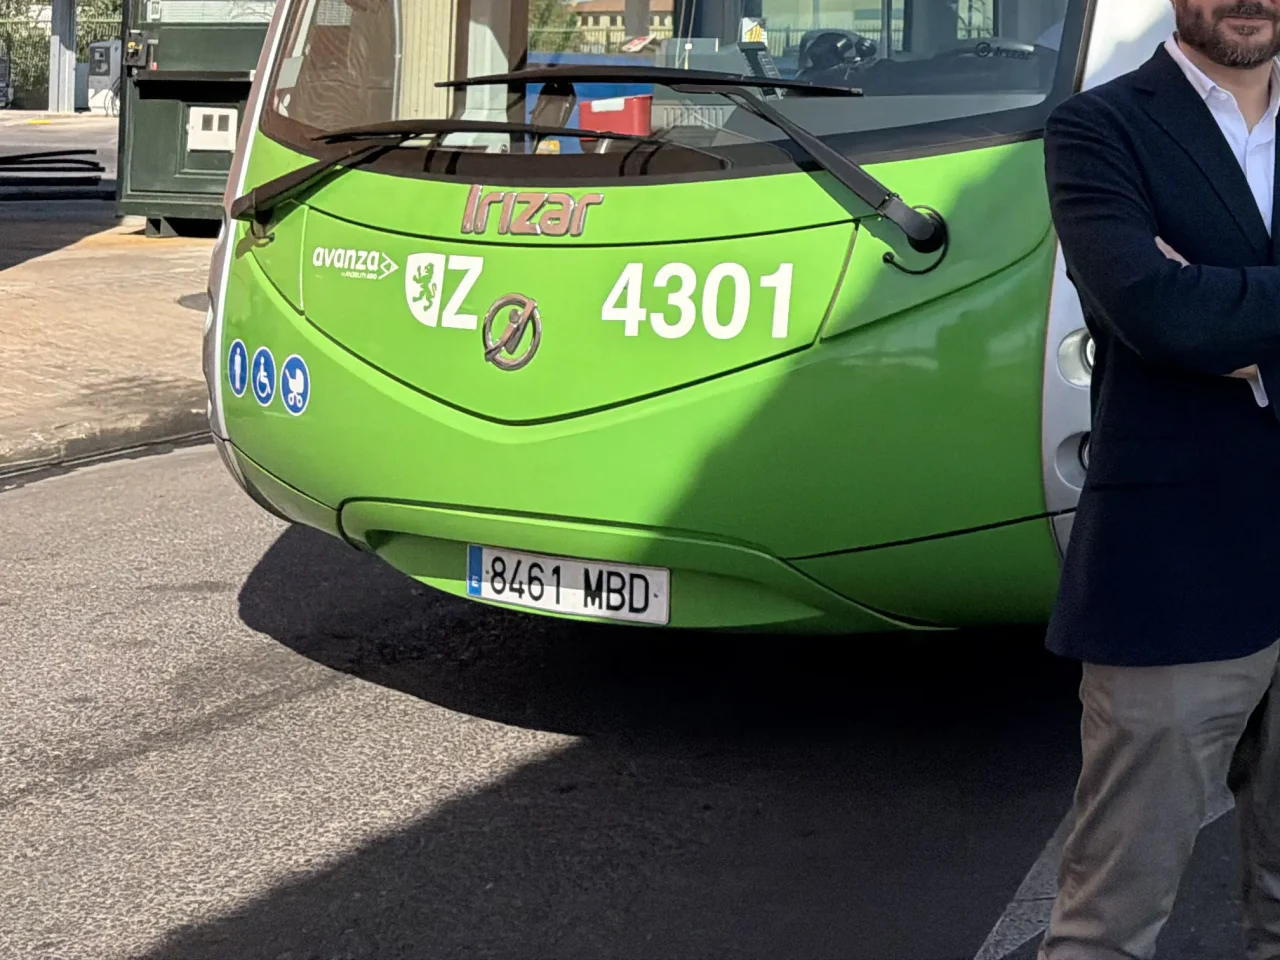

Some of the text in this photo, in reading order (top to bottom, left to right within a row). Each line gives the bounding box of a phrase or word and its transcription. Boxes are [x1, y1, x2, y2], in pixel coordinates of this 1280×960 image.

[460, 184, 605, 238] Irizar
[312, 246, 380, 272] avanza
[440, 254, 484, 331] Z
[601, 262, 794, 340] 4301
[490, 556, 650, 614] 8461 MBD
